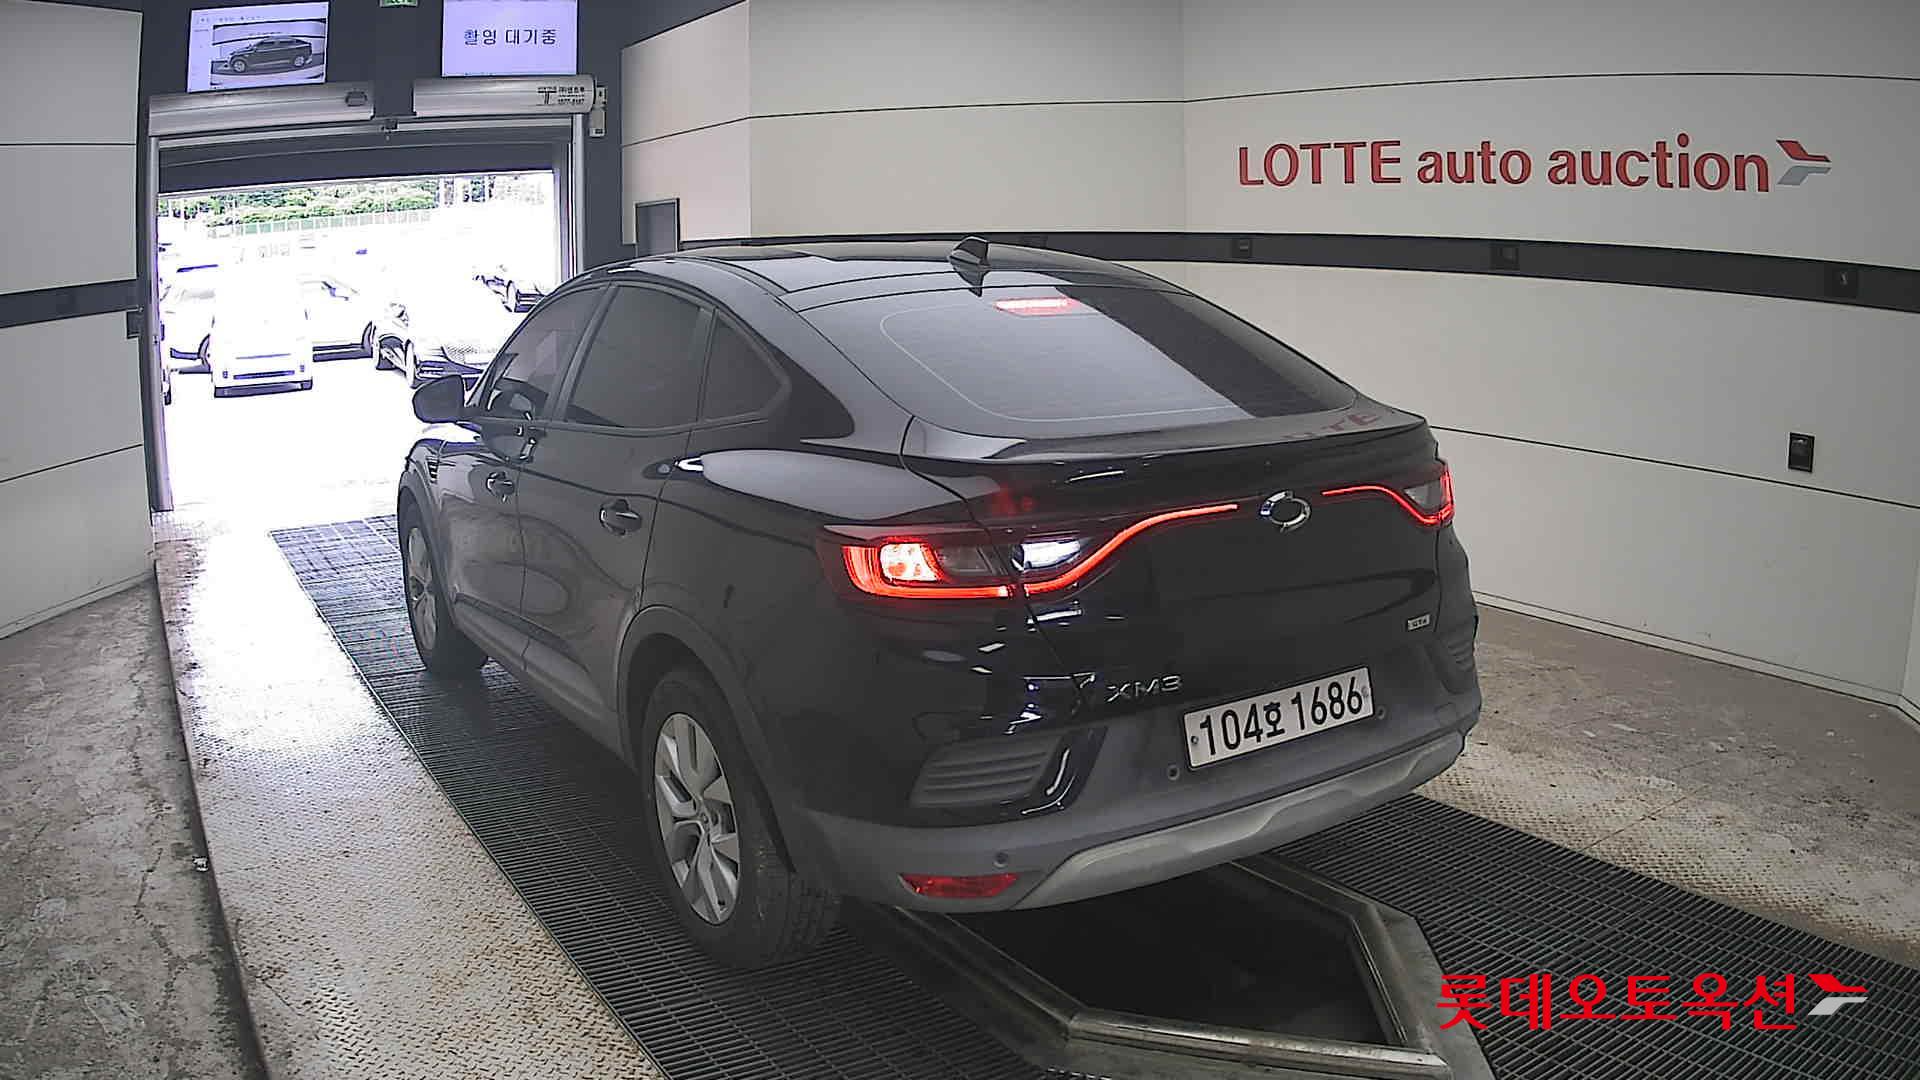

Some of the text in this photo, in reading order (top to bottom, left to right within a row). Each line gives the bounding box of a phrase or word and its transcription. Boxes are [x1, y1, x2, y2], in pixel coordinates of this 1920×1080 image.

[505, 29, 557, 45] 대기중
[1239, 134, 1771, 192] LOTTE auto auction
[1107, 675, 1182, 703] XM3
[1199, 676, 1363, 756] 104호 1686
